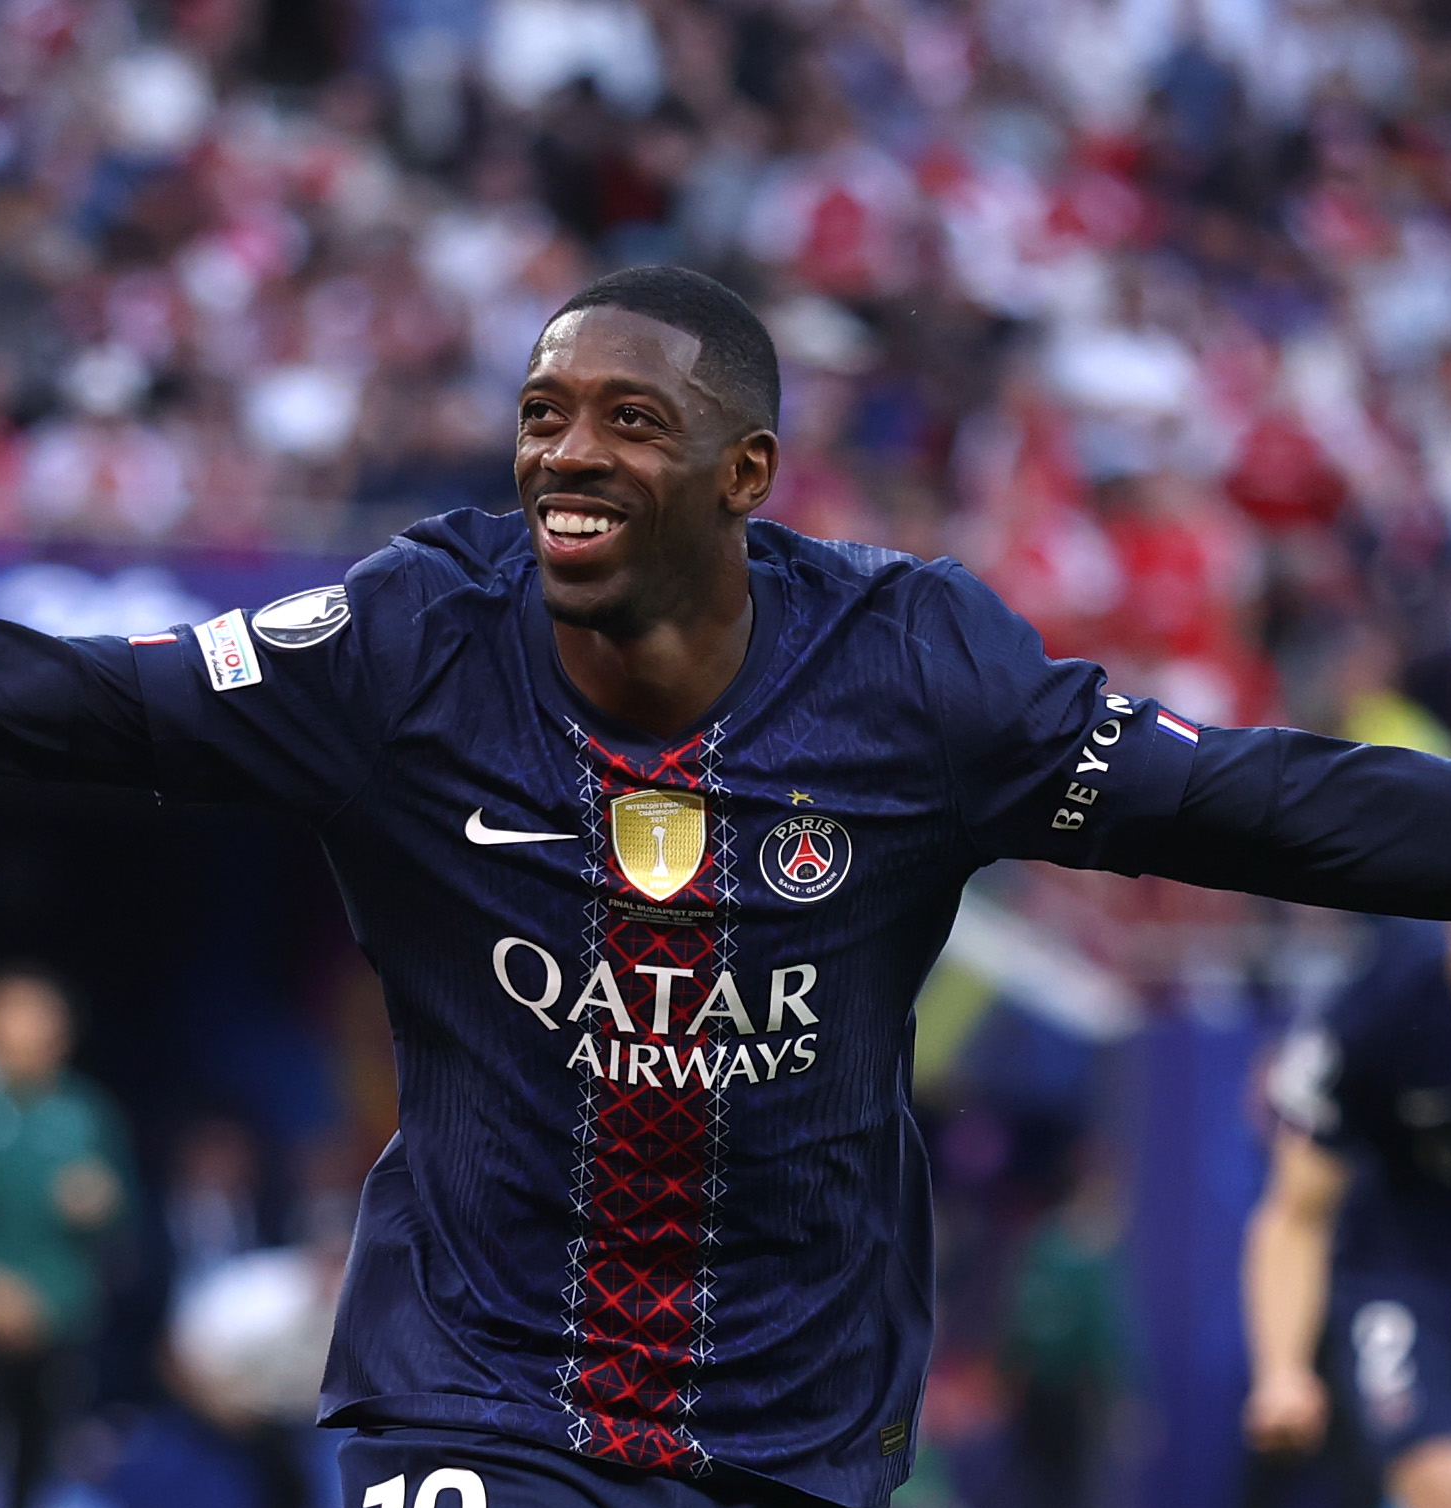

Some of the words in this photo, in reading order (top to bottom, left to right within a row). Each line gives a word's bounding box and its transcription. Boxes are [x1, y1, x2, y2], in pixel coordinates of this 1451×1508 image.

[774, 818, 835, 840] PARIS
[608, 899, 636, 910] FINAL
[636, 904, 687, 917] BUDAPEST
[492, 936, 820, 1035] QATAR
[566, 1032, 818, 1089] AIRWAYS
